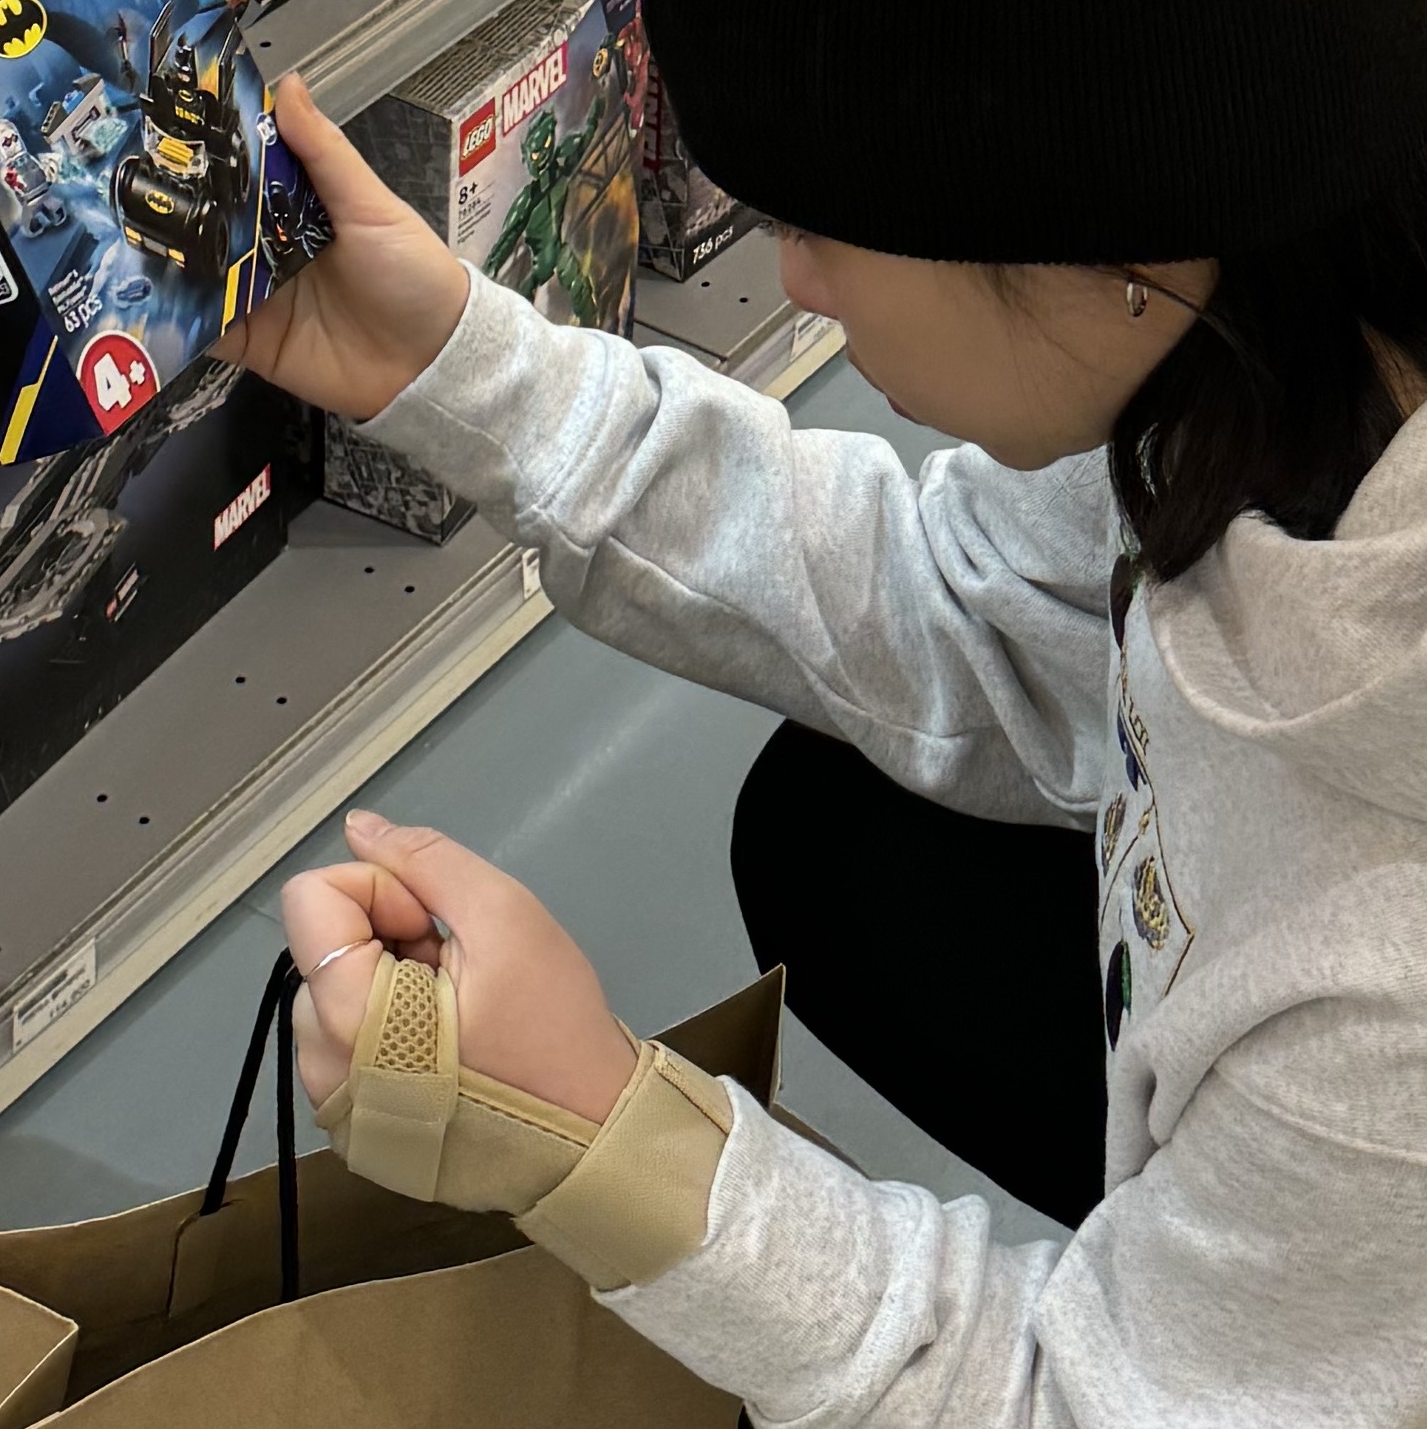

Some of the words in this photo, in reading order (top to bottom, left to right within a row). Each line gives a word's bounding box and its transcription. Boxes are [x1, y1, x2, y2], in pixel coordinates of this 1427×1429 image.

[502, 46, 567, 137] MARVEL
[461, 115, 494, 162] LEGO
[458, 181, 478, 205] 8+
[692, 236, 712, 265] 736
[714, 224, 735, 251] pcs
[64, 310, 81, 333] 63
[78, 296, 103, 329] pcs
[93, 351, 146, 412] 4+
